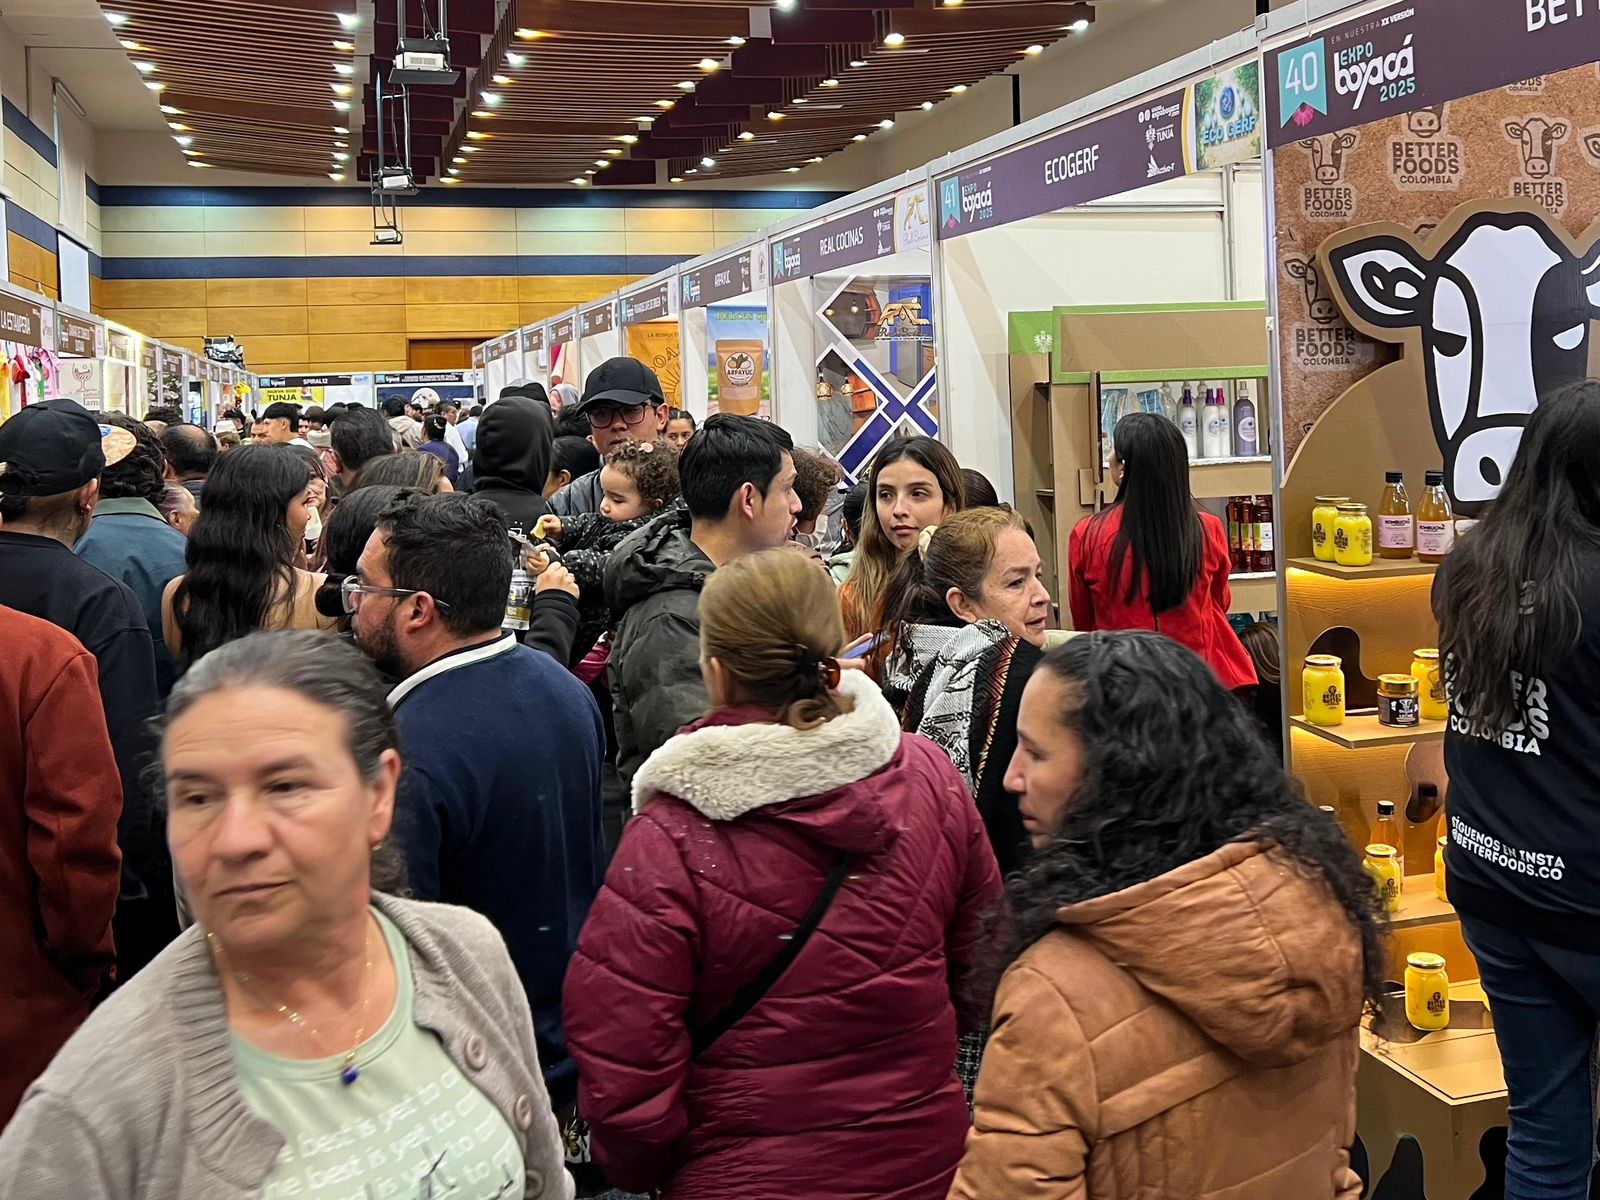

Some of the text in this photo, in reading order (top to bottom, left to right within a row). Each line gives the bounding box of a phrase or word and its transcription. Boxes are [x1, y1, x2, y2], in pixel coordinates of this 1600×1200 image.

[1331, 8, 1415, 44] EN NUESTRA XX VERSIÓN
[1339, 41, 1374, 66] EXPO
[1285, 51, 1318, 95] 40
[1333, 33, 1414, 110] boyacá
[1380, 77, 1416, 102] 2025
[1156, 128, 1174, 142] TUNJA
[1203, 115, 1256, 144] ECO GERF
[1391, 141, 1459, 158] BETTER
[1044, 144, 1100, 185] ECOGERF
[1392, 158, 1459, 174] FOODS
[1400, 175, 1454, 185] COLOMBIA
[1513, 182, 1563, 195] BETTER
[944, 183, 956, 208] 41
[961, 181, 992, 223] boyacá
[1304, 187, 1352, 199] BETTER
[1304, 199, 1352, 211] FOODS
[1309, 210, 1348, 218] COLOMBIA
[819, 226, 864, 257] REAL COCINAS
[1296, 327, 1356, 342] BETTER
[1296, 342, 1356, 357] FOODS
[1302, 357, 1351, 366] COLOMBIA
[1451, 714, 1541, 756] COLOBIA
[1451, 828, 1563, 881] @BETTERFOODS.CO
[1452, 815, 1566, 869] SÍGUENOS EN INSTA
[304, 1153, 365, 1191] best
[430, 1109, 457, 1134] to
